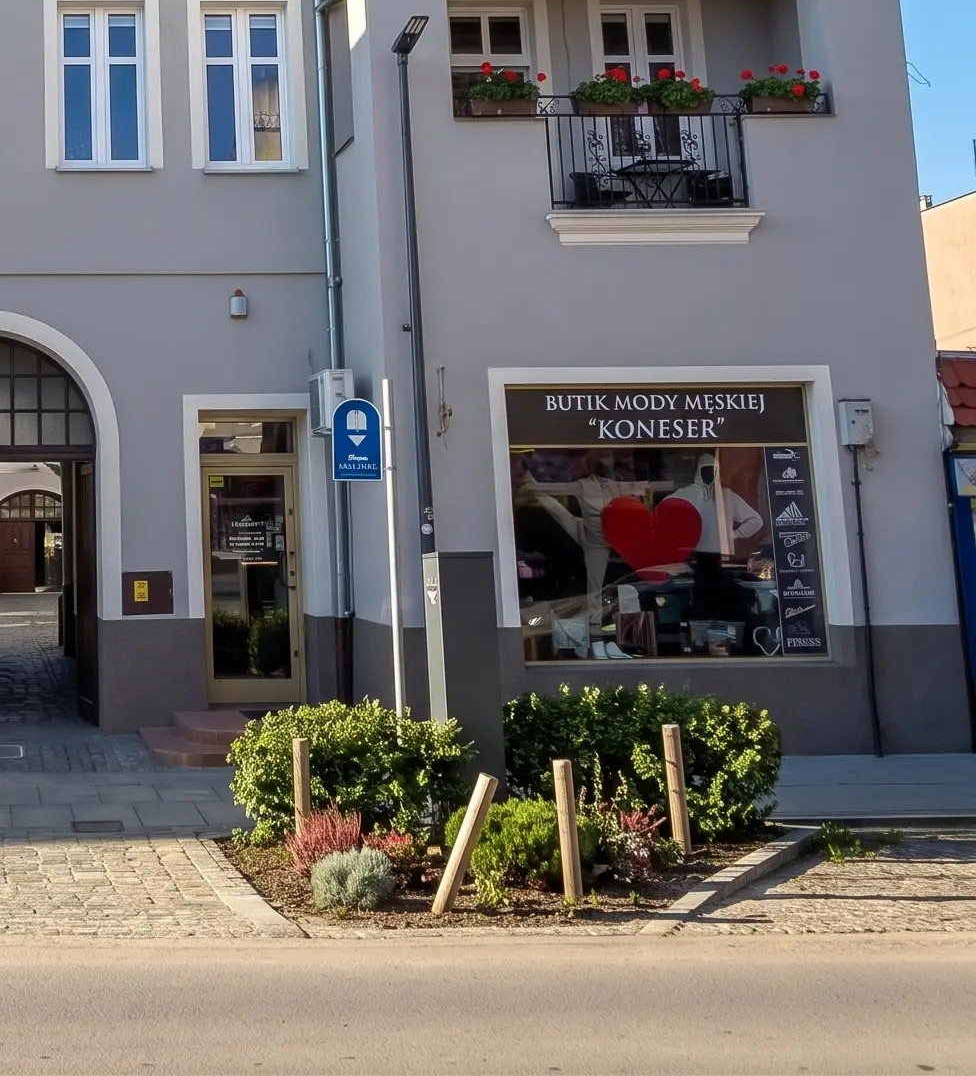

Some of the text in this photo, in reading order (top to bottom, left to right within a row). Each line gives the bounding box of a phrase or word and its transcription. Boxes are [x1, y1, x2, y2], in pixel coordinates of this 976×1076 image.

[545, 393, 765, 414] BUTIK MODY MĘSKIEJ
